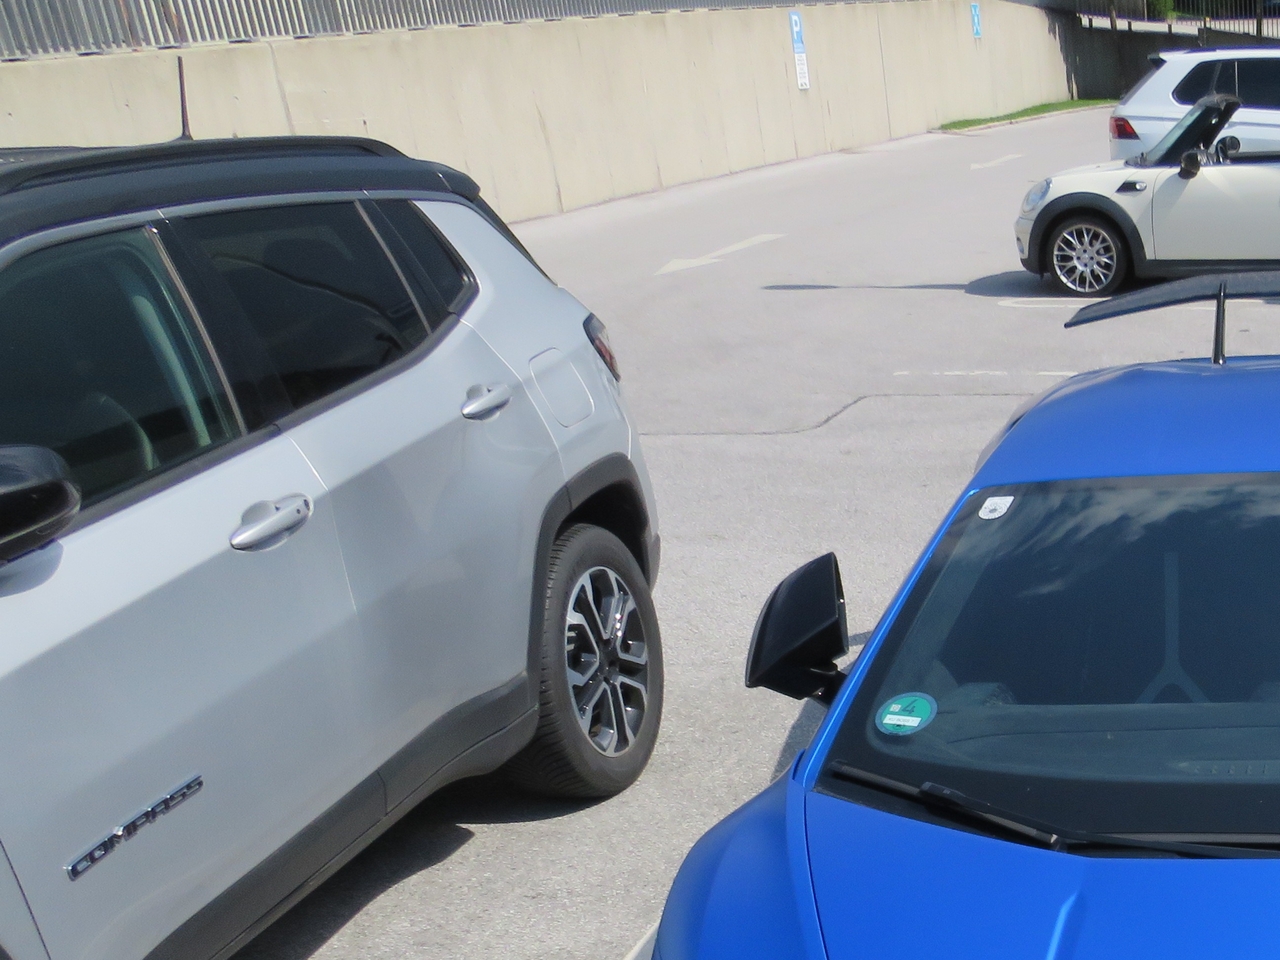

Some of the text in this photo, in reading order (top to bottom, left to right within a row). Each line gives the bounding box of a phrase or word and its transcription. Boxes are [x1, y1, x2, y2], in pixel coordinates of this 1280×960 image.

[791, 15, 801, 40] P
[901, 699, 918, 714] 4
[64, 775, 204, 881] COMPASS
